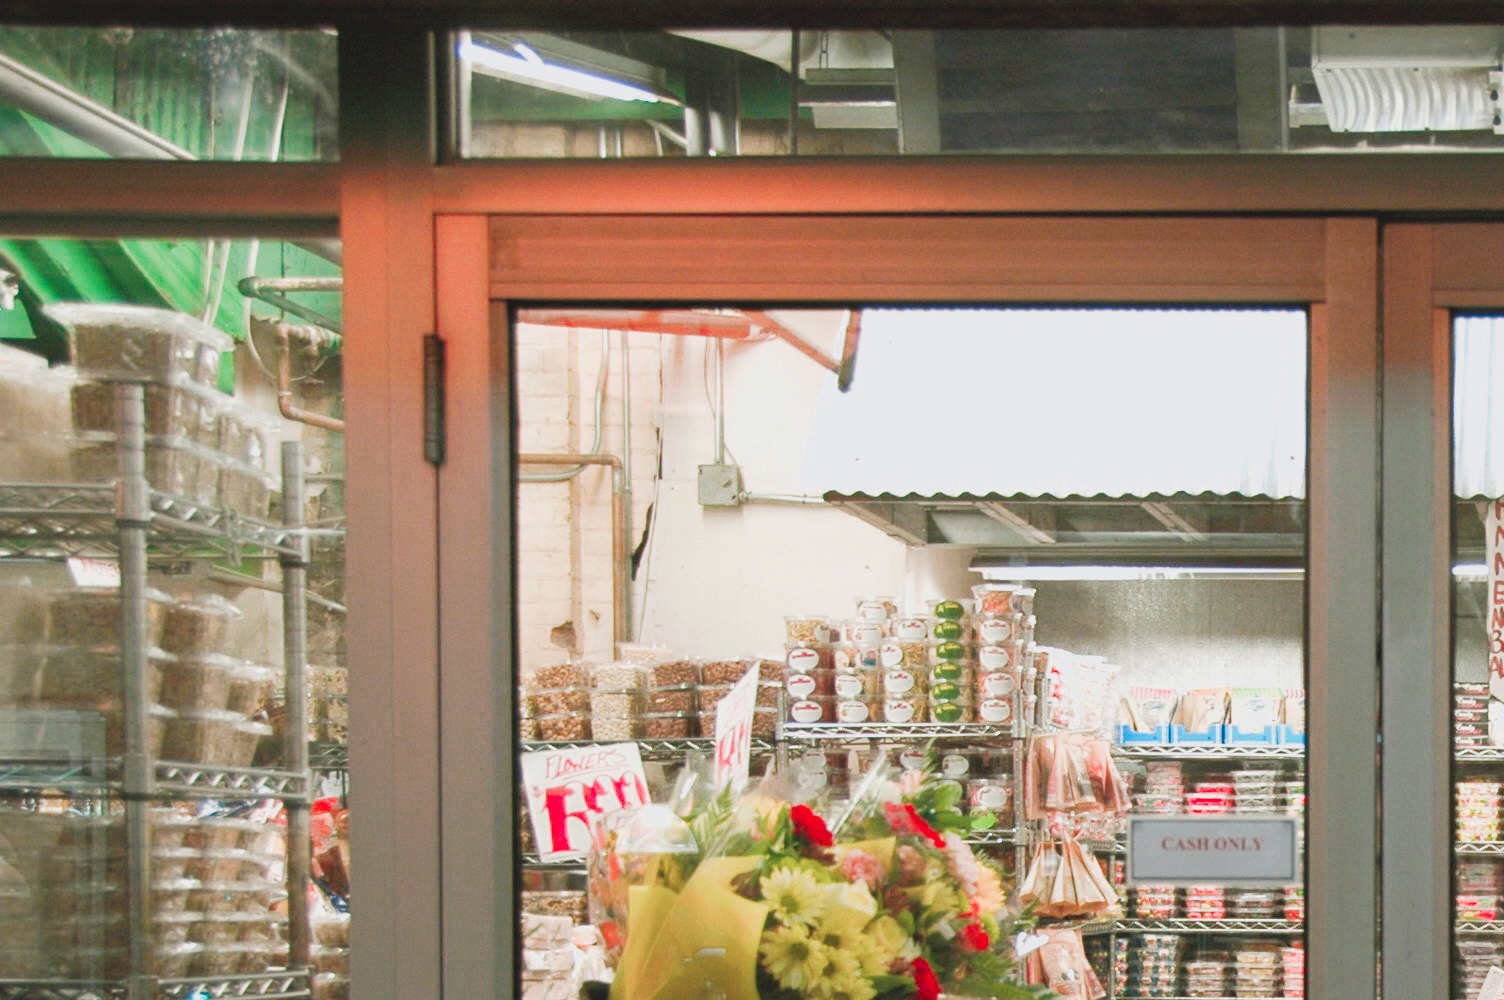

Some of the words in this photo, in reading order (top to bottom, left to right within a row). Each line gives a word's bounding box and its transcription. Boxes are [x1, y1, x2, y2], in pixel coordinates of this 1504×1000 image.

[546, 749, 630, 778] FLOWERS
[1161, 837, 1210, 851] CASH
[1214, 837, 1265, 851] ONLY
